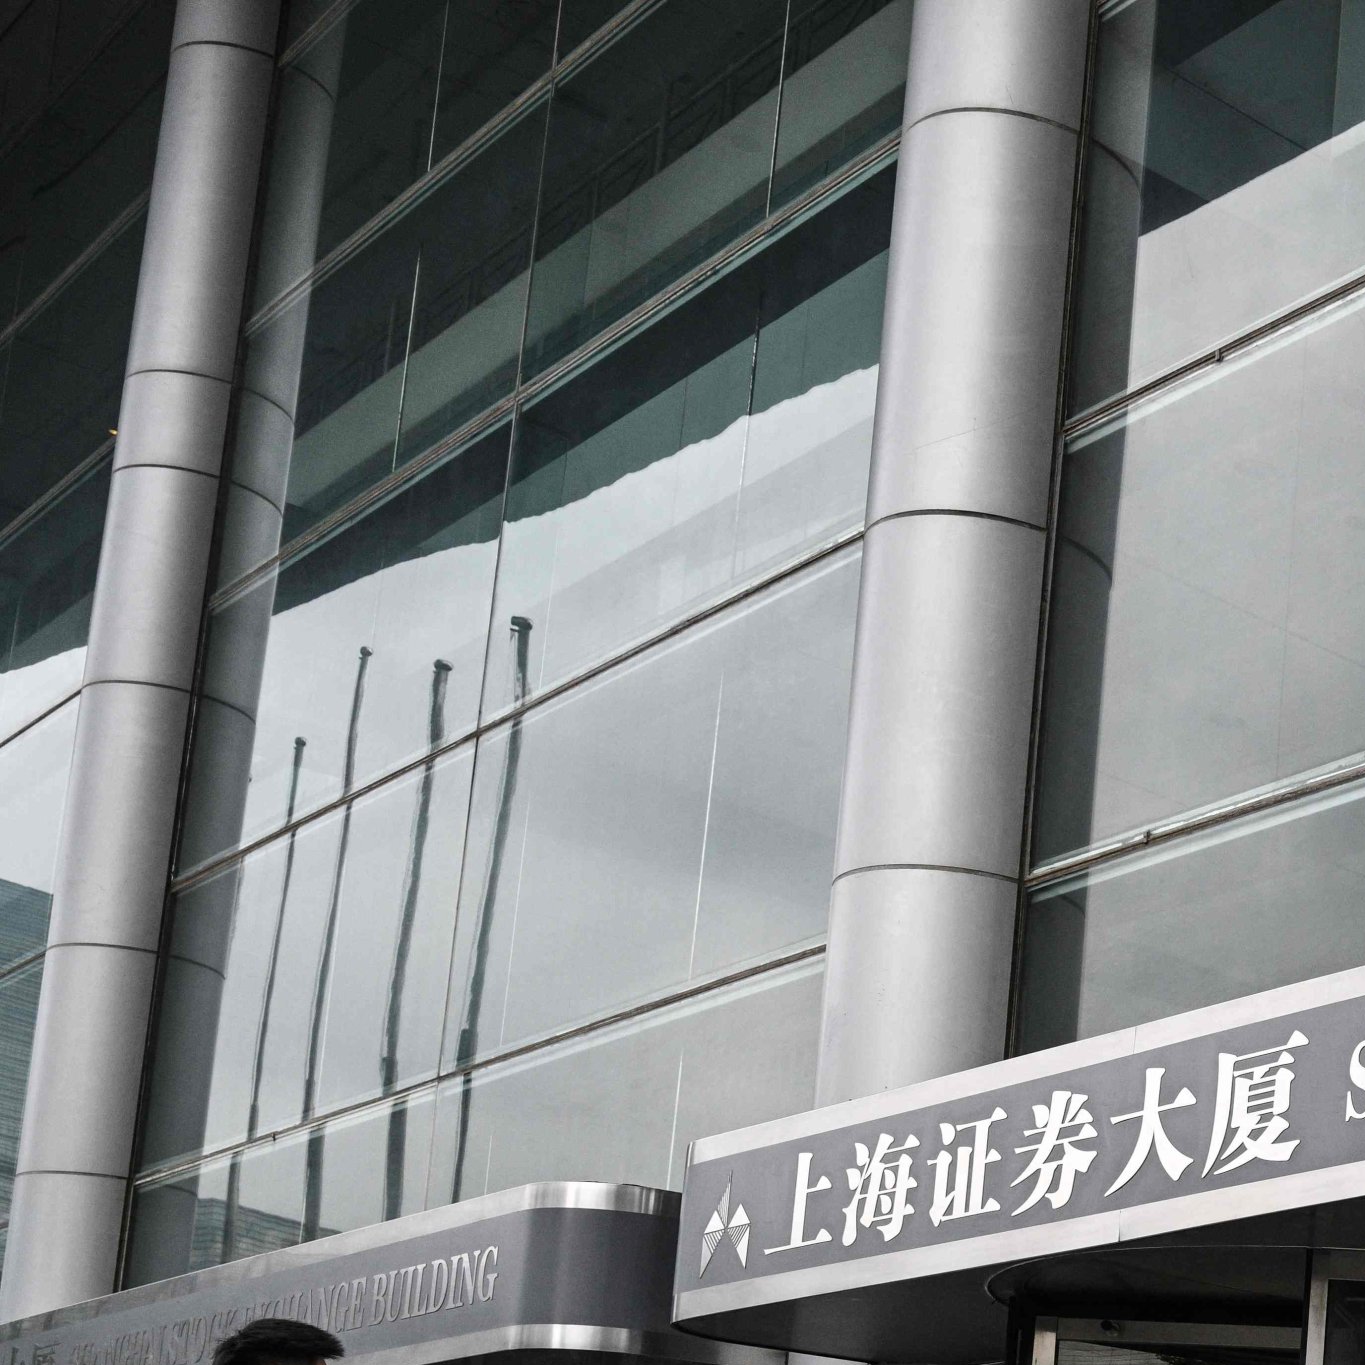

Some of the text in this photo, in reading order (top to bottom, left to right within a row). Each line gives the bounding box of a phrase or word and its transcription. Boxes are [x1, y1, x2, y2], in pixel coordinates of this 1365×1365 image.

[764, 1030, 1310, 1255] 上海证券大厦
[368, 1246, 499, 1327] BUILDING
